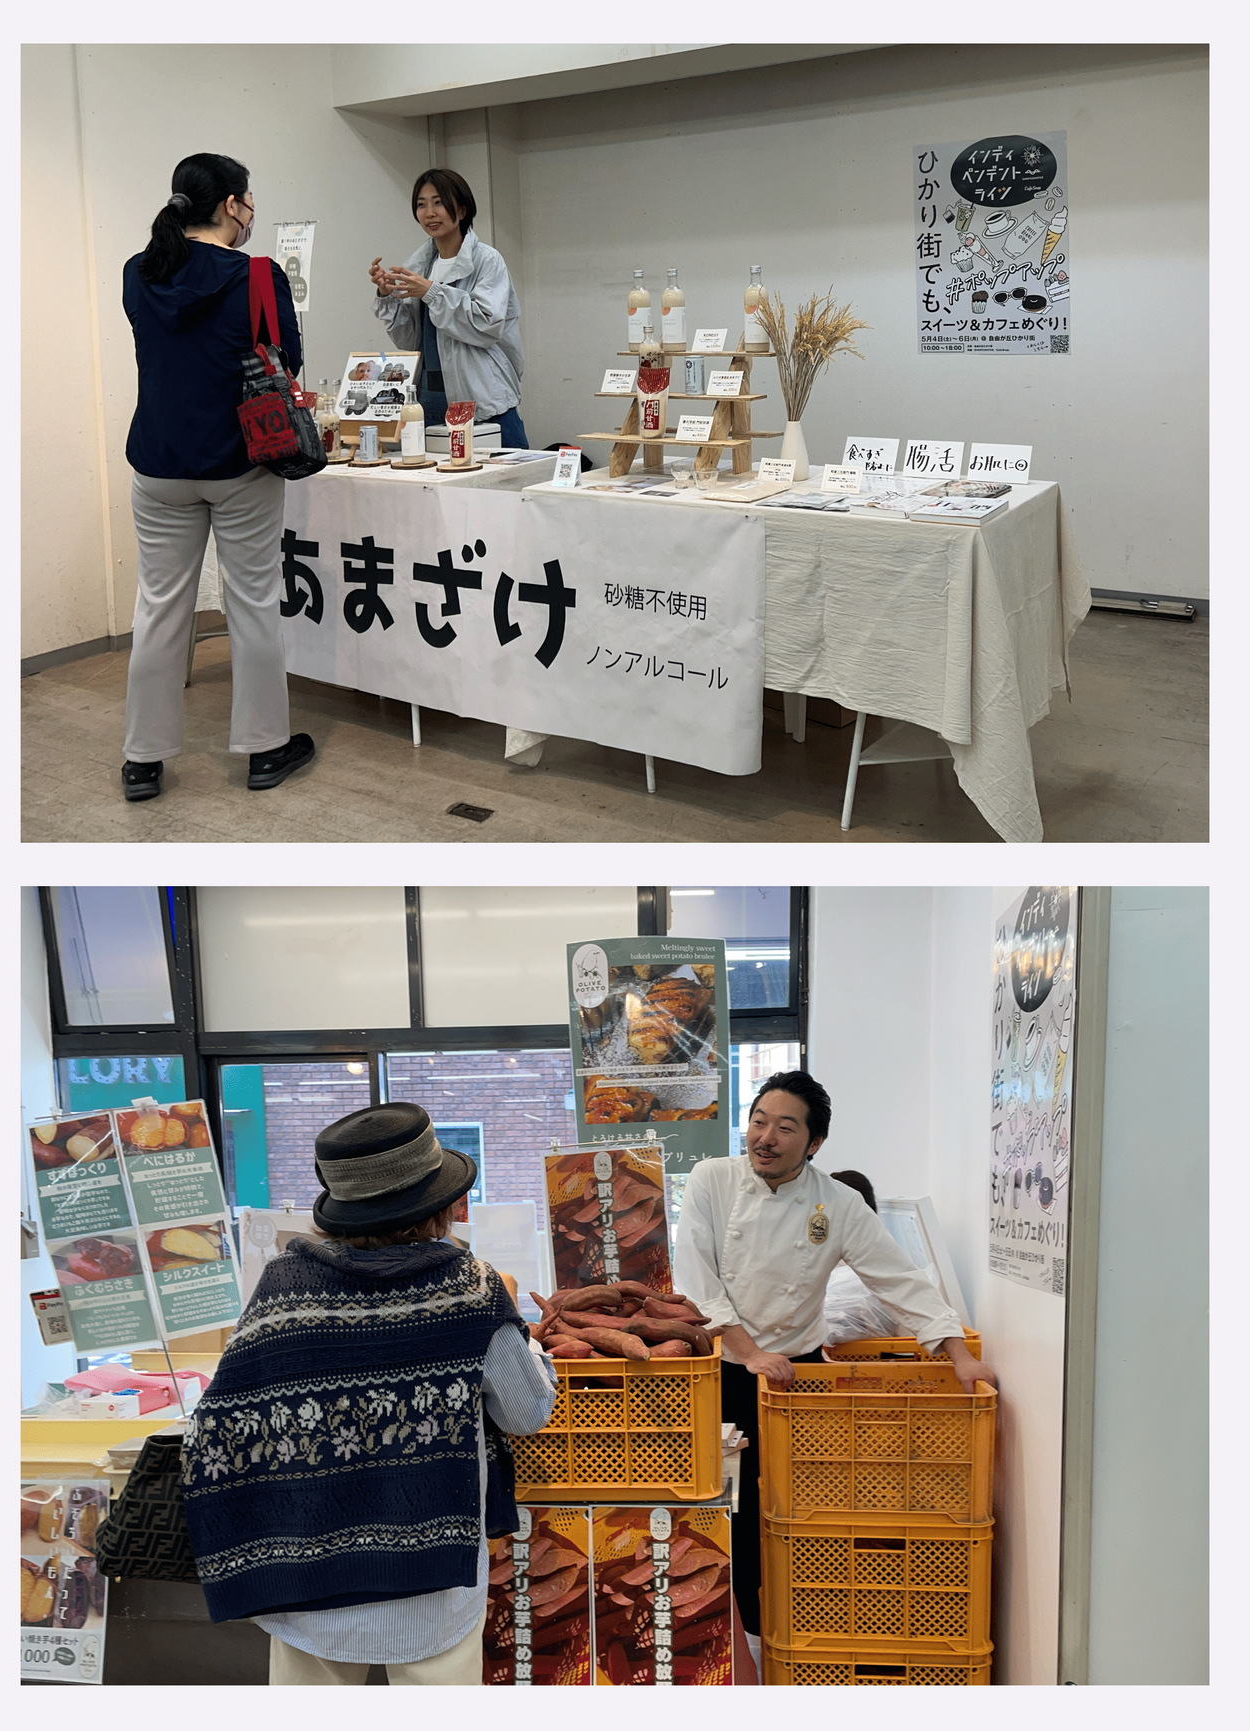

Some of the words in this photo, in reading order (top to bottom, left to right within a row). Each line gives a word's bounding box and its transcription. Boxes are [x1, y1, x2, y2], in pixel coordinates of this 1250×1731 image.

[968, 146, 1014, 164] インディ
[962, 165, 1022, 184] ペンデント
[916, 150, 952, 314] ひかり街でも、
[907, 444, 956, 474] 腸活
[604, 582, 708, 621] 砂糖不使用
[586, 645, 729, 690] ノンアルコール
[661, 944, 694, 953] Meltingly
[672, 953, 693, 961] potato
[575, 985, 606, 993] POTATO
[578, 980, 602, 988] OLIVE
[143, 1151, 196, 1166] べにはるか
[163, 1263, 225, 1282] シルクスイート
[75, 1278, 134, 1296] ふくむらさき
[512, 1542, 533, 1685] 訳アリお芋詰め放
[652, 1542, 673, 1685] 訳アリお芋詰め放
